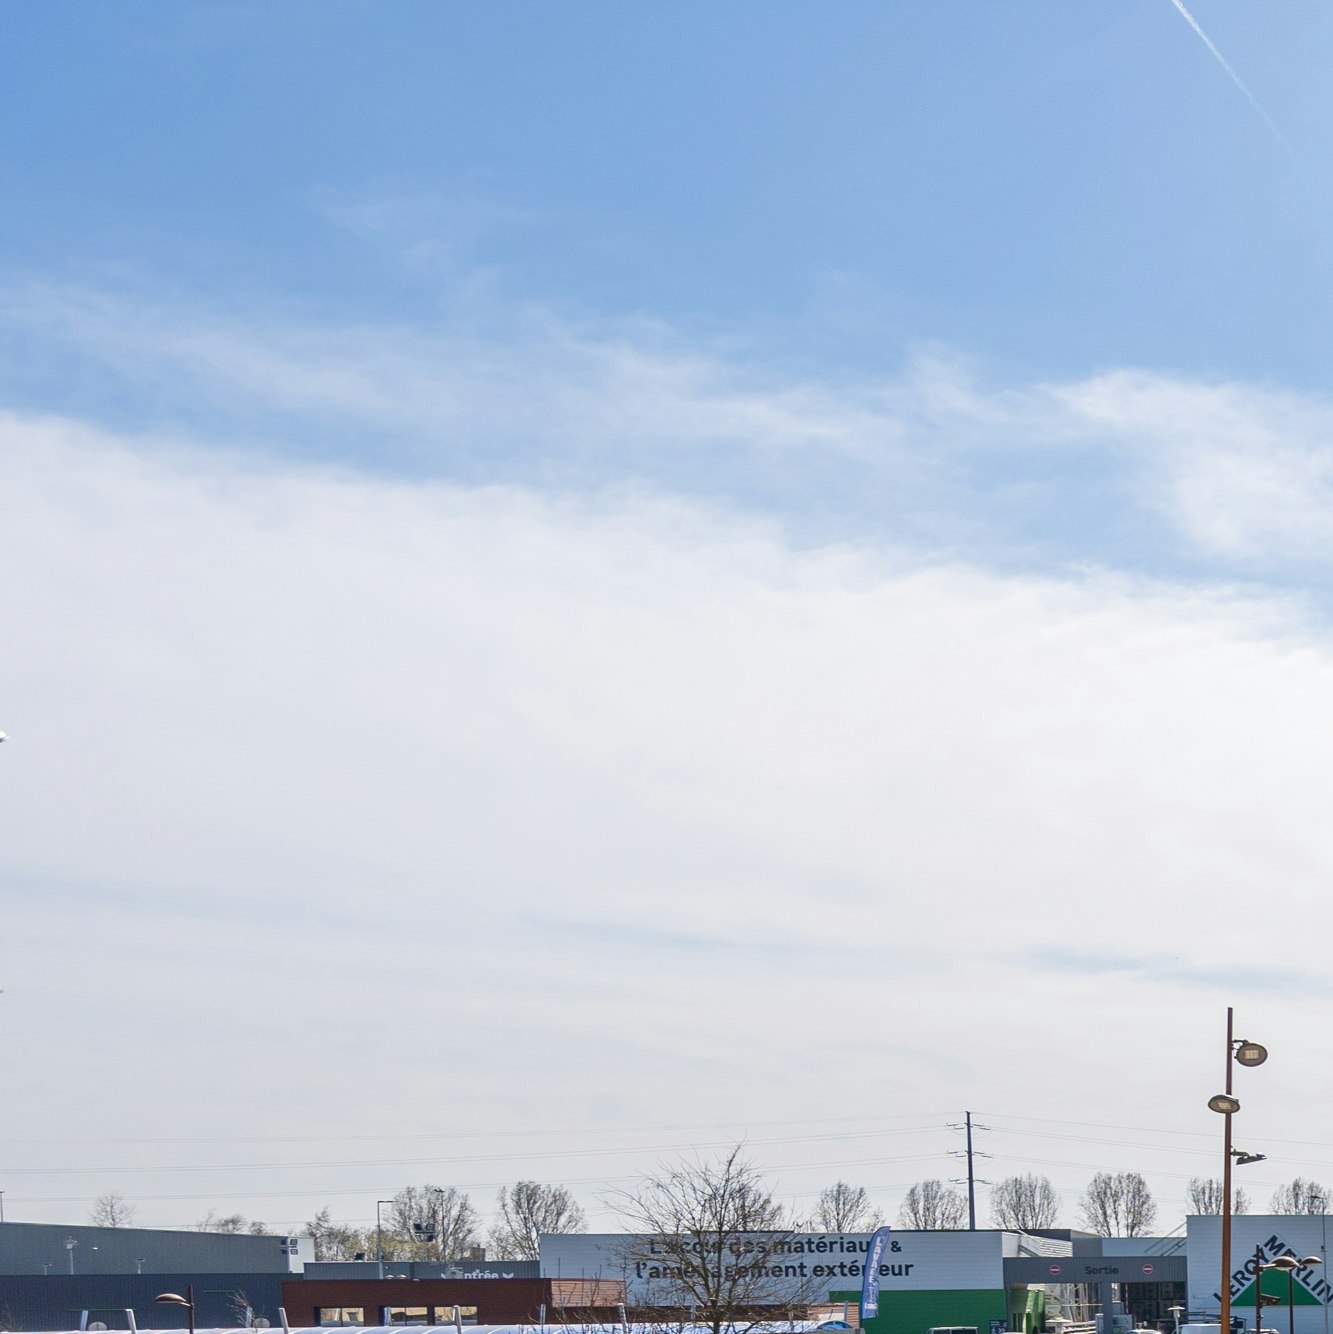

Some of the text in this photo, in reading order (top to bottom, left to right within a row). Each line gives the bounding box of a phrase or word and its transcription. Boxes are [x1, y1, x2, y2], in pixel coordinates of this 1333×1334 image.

[773, 1235, 869, 1254] matériau
[890, 1240, 903, 1253] &
[813, 1259, 914, 1277] extéreur
[1084, 1265, 1120, 1275] Sortie
